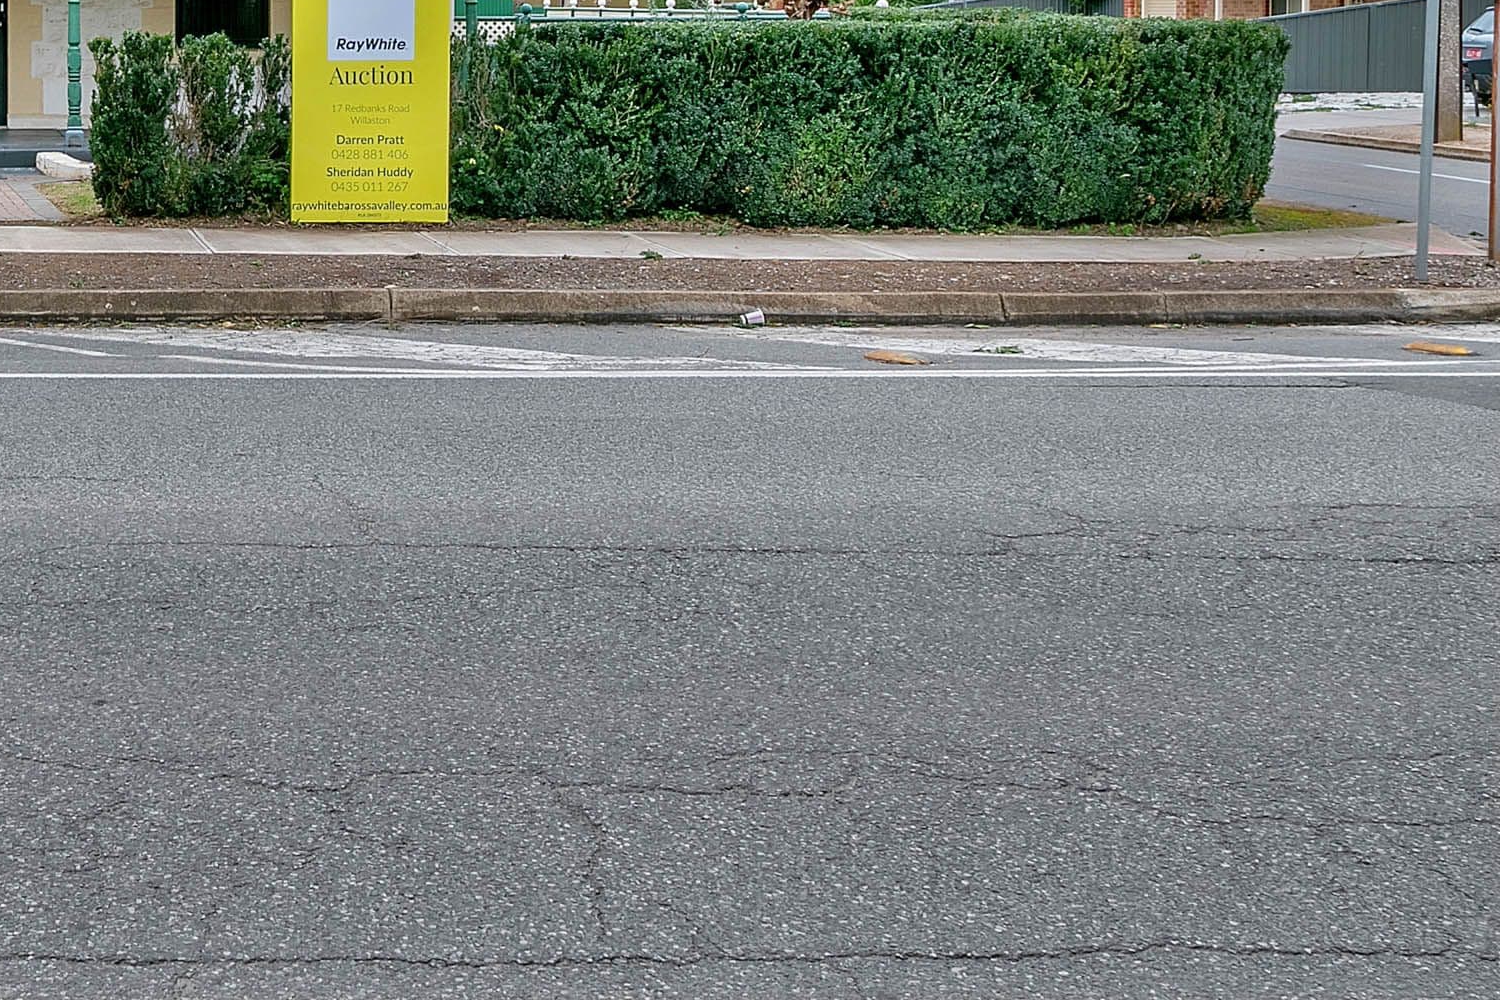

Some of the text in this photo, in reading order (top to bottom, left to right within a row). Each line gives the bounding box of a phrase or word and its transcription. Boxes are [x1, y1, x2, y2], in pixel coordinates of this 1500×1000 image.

[329, 65, 413, 85] Auction
[332, 103, 410, 113] 17 Redbanks Road
[350, 115, 391, 125] Willaston
[336, 134, 405, 145] Darren Pratt
[331, 148, 409, 160] 0428 881 406
[326, 166, 414, 179] Sheridan Huddy
[331, 181, 409, 192] 0435 011 267
[292, 201, 448, 212] raywhitebarossavalley.com.au
